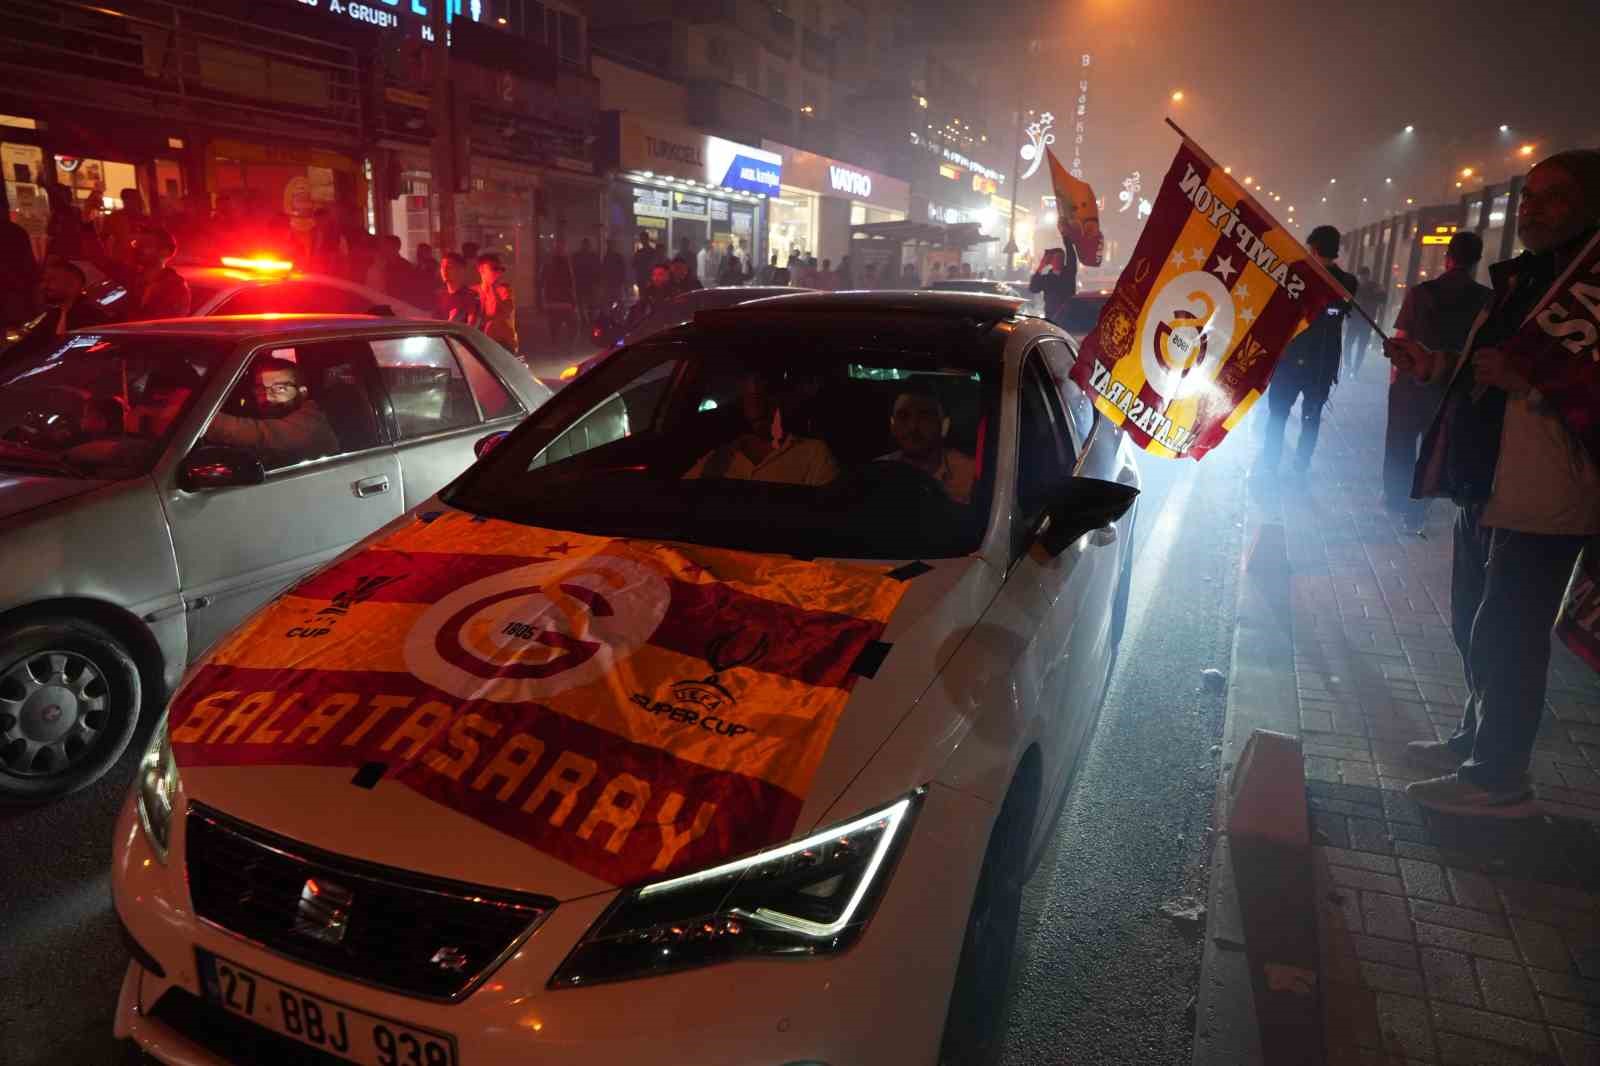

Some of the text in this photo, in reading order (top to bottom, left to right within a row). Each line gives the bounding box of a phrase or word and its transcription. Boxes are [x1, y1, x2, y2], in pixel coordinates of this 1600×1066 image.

[830, 165, 873, 198] VAYRO
[285, 626, 331, 639] CUP
[629, 692, 750, 738] SUPER CUP
[171, 688, 717, 872] GALATASARAY
[218, 966, 257, 1015] 27
[278, 989, 350, 1053] BBJ
